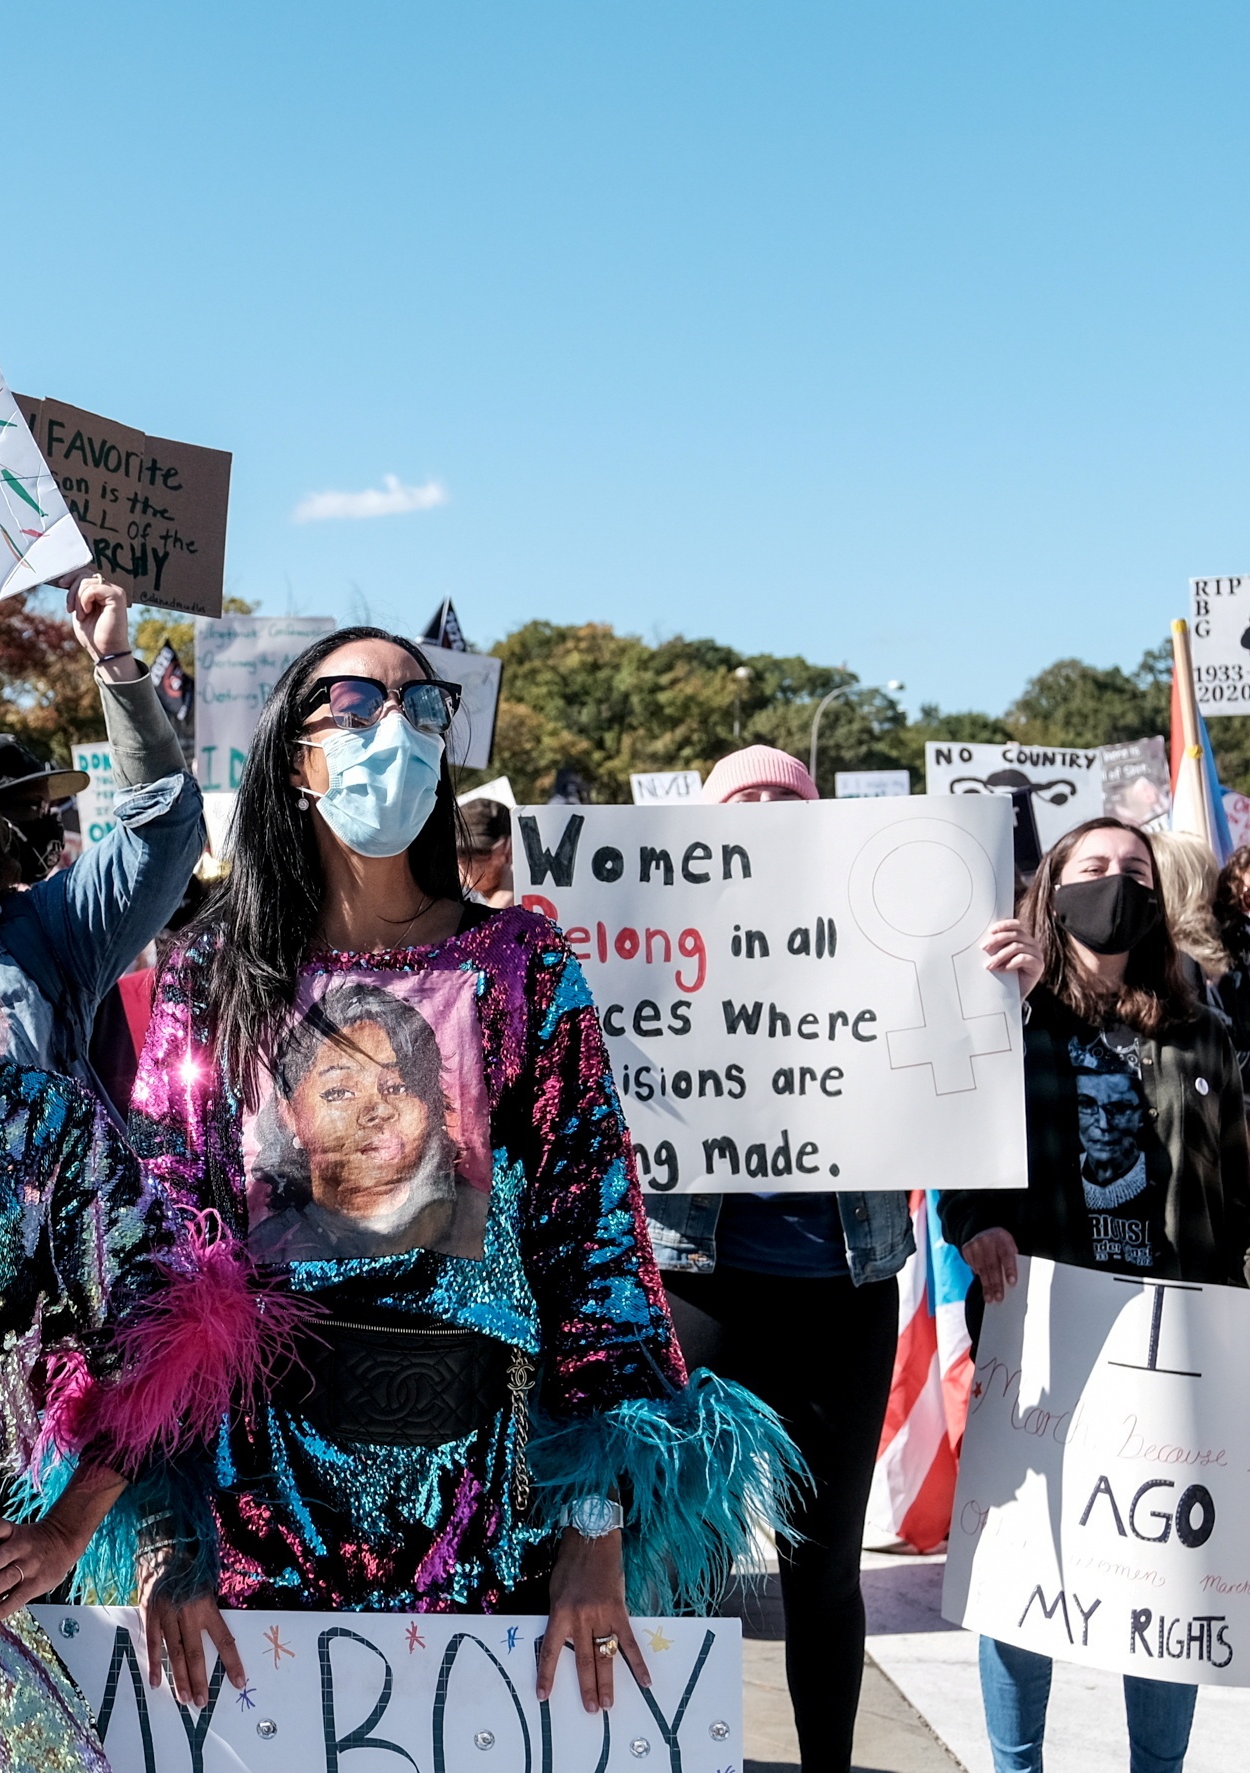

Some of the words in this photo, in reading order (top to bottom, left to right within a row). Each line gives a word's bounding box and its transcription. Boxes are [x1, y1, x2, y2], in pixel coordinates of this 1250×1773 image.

[62, 494, 120, 533] ALL
[159, 529, 200, 555] the
[100, 482, 120, 504] is
[126, 492, 175, 522] the
[935, 747, 973, 766] NO
[1001, 749, 1098, 770] COUNTRY
[518, 813, 752, 887] Women
[731, 924, 770, 959] in
[787, 916, 838, 960] all
[602, 999, 693, 1038] ces
[623, 1062, 747, 1100] isions
[772, 1064, 845, 1098] are
[1108, 1276, 1204, 1378] I
[1078, 1474, 1216, 1549] AGO
[1017, 1583, 1102, 1647] MY
[1129, 1606, 1233, 1669] RIGHTS
